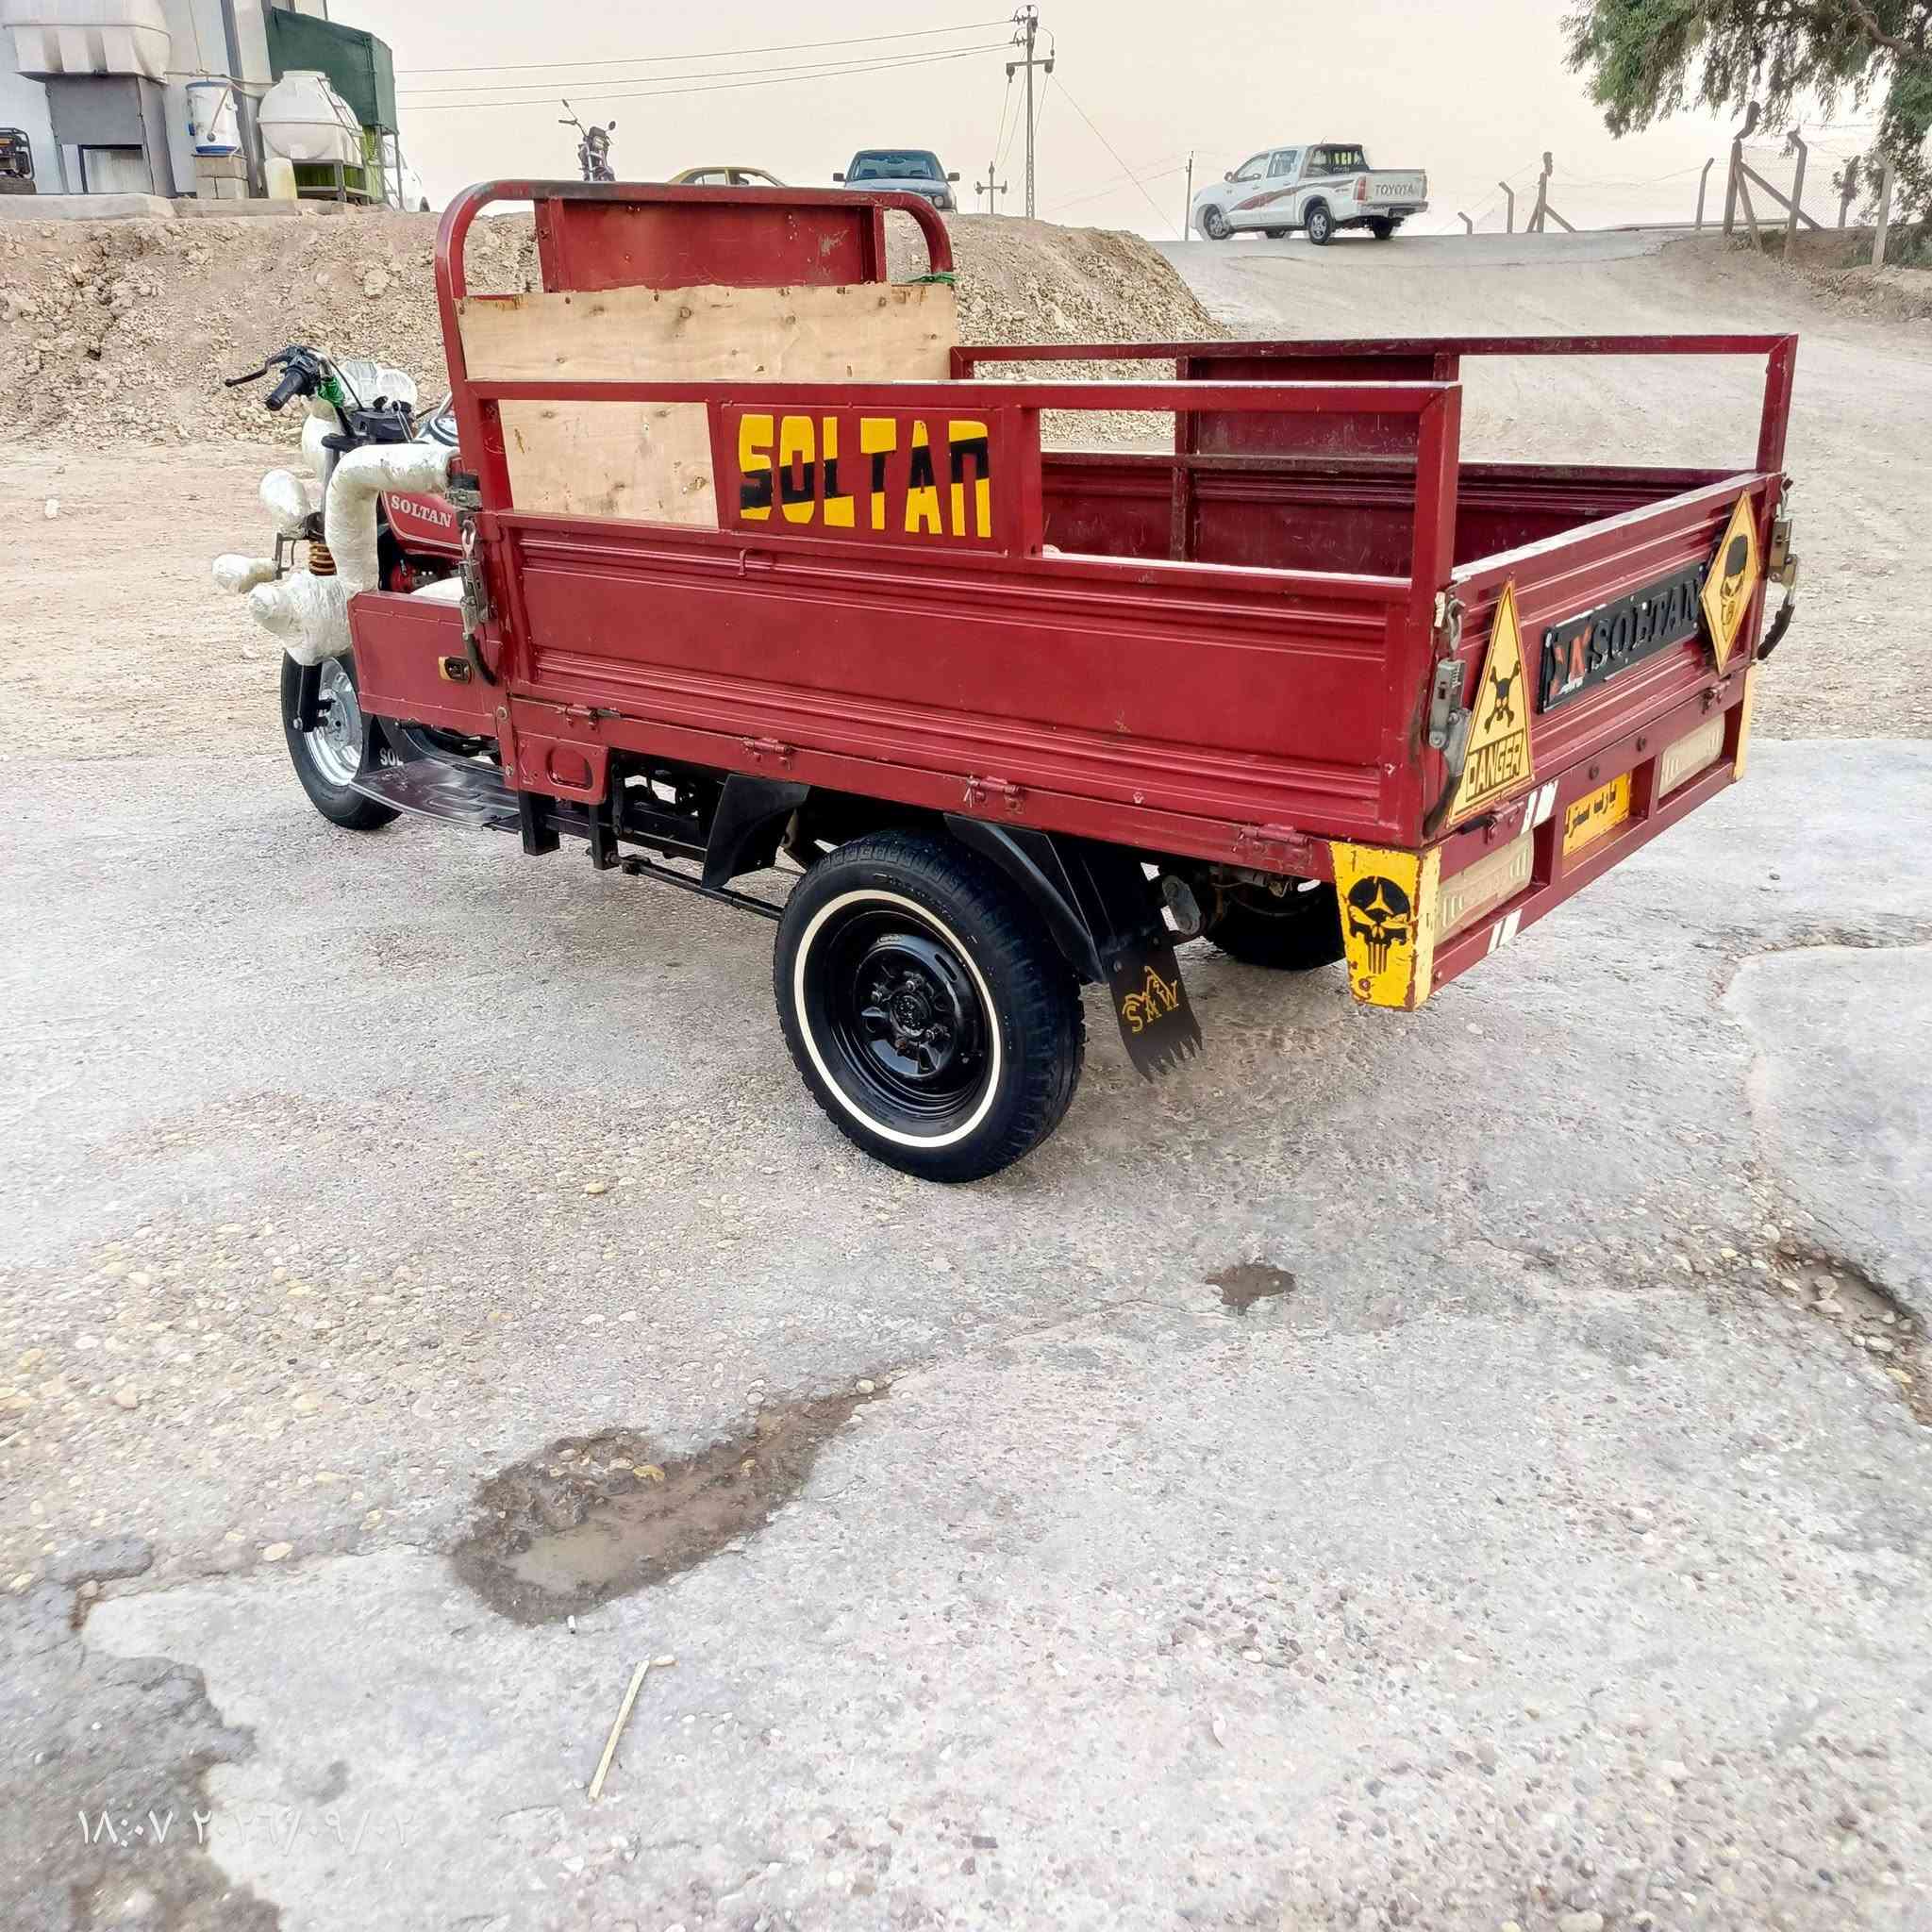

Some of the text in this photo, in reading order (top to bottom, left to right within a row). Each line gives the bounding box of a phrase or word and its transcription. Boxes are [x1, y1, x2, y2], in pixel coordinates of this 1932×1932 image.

[1374, 183, 1416, 196] TOYOTA
[391, 494, 452, 528] SOLTAN
[1465, 731, 1523, 800] DANGER
